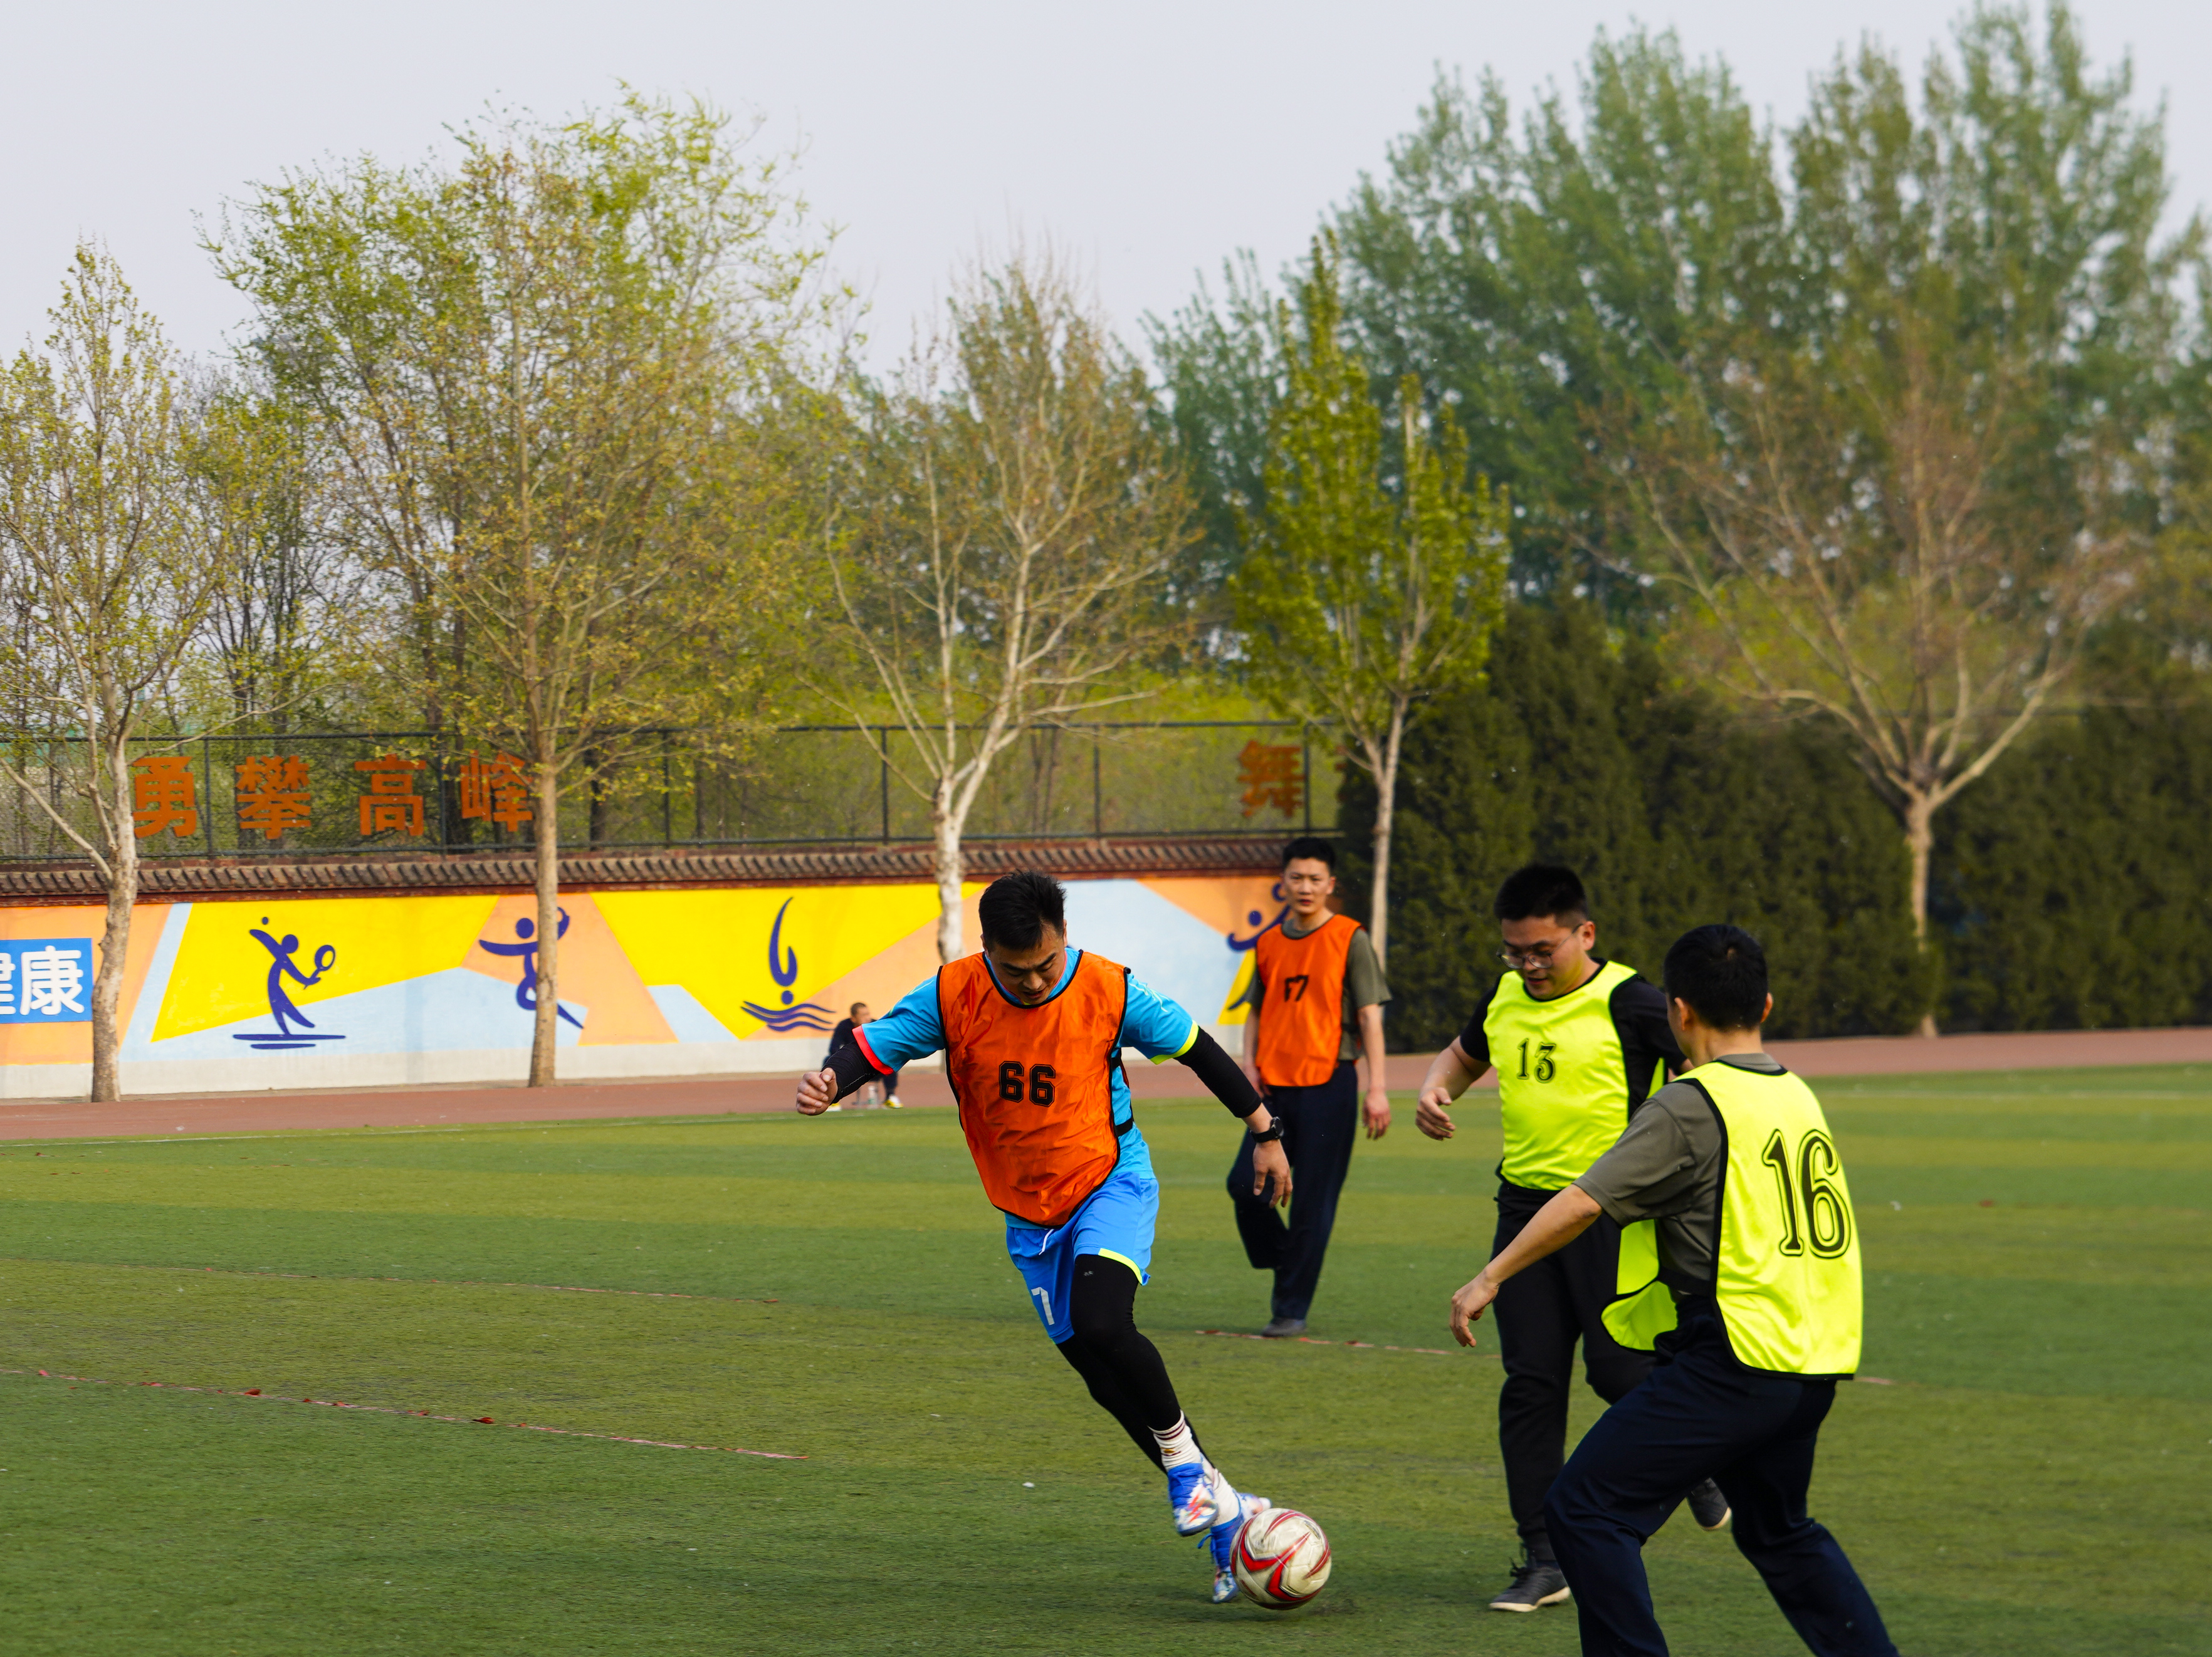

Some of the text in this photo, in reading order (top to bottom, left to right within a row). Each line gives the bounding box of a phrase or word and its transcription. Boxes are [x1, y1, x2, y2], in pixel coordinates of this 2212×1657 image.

[132, 750, 533, 840] 勇攀高峰
[999, 1060, 1056, 1107] 66
[1516, 1038, 1556, 1084] 13
[1761, 1129, 1851, 1259] 16
